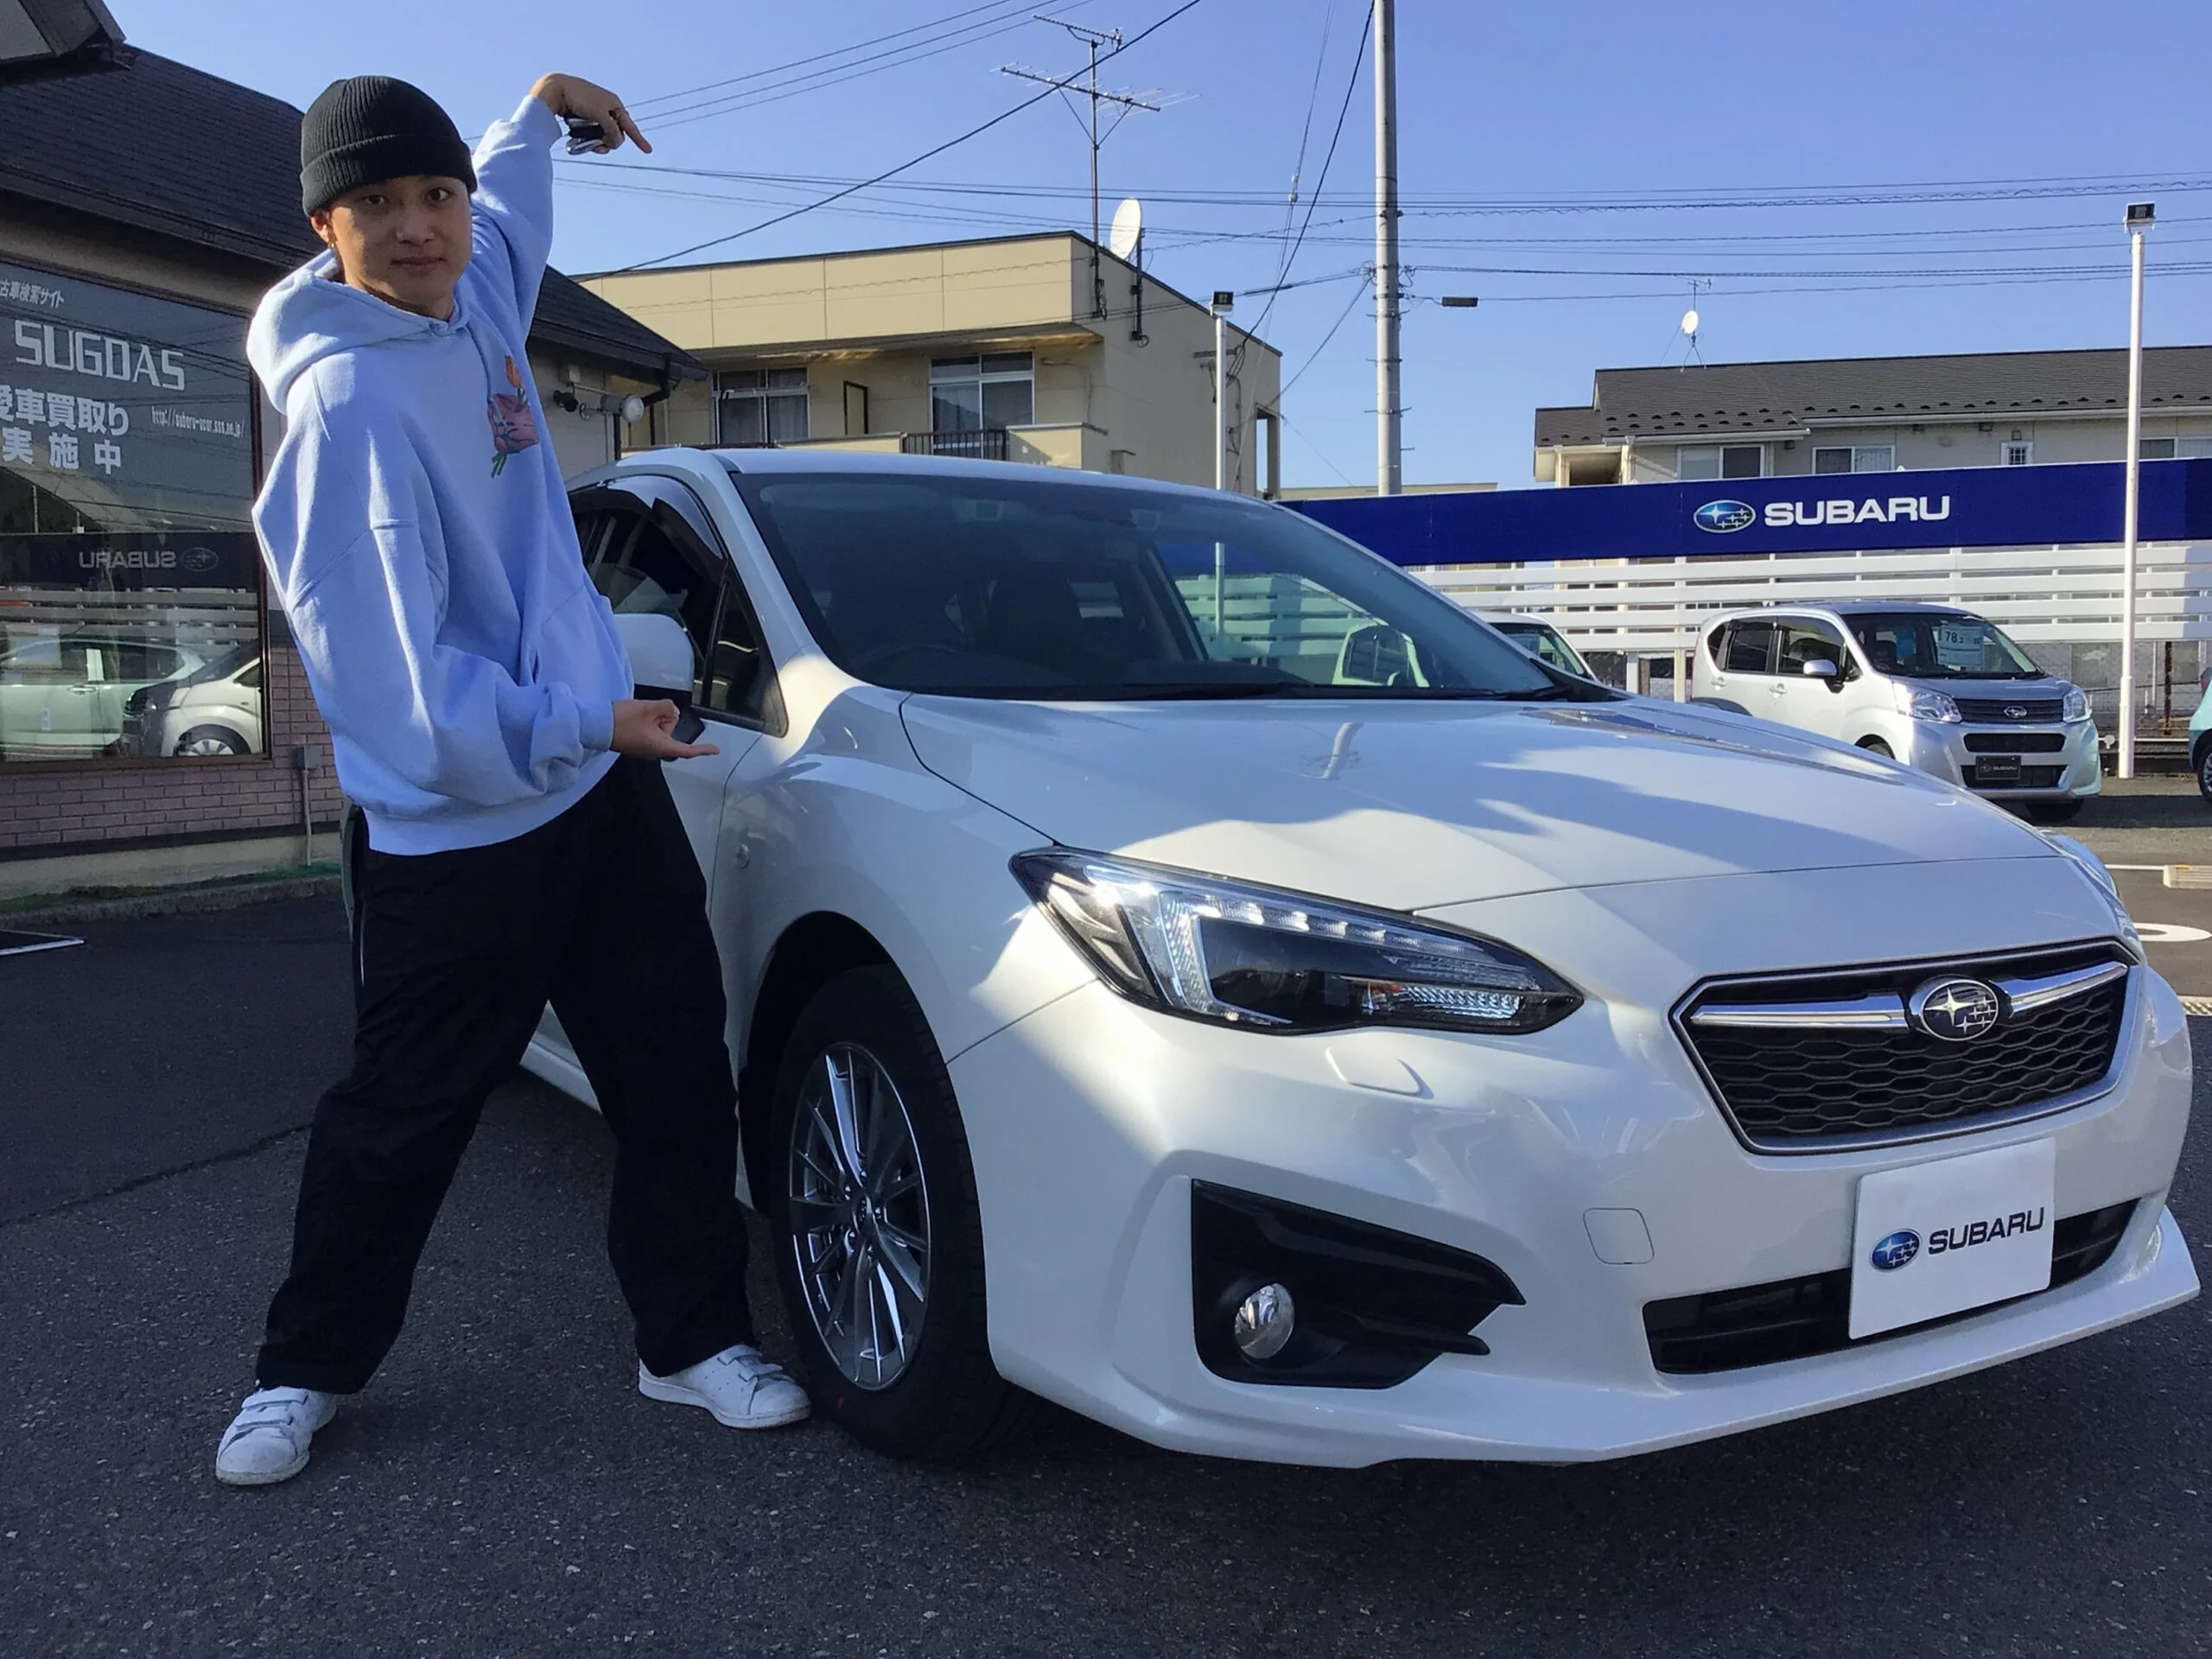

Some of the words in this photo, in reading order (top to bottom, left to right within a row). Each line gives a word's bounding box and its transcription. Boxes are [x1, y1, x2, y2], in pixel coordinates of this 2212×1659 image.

[14, 320, 185, 391] SUGDAS
[1764, 496, 1950, 526] SUBARU
[1928, 1206, 2045, 1255] SUBARU
